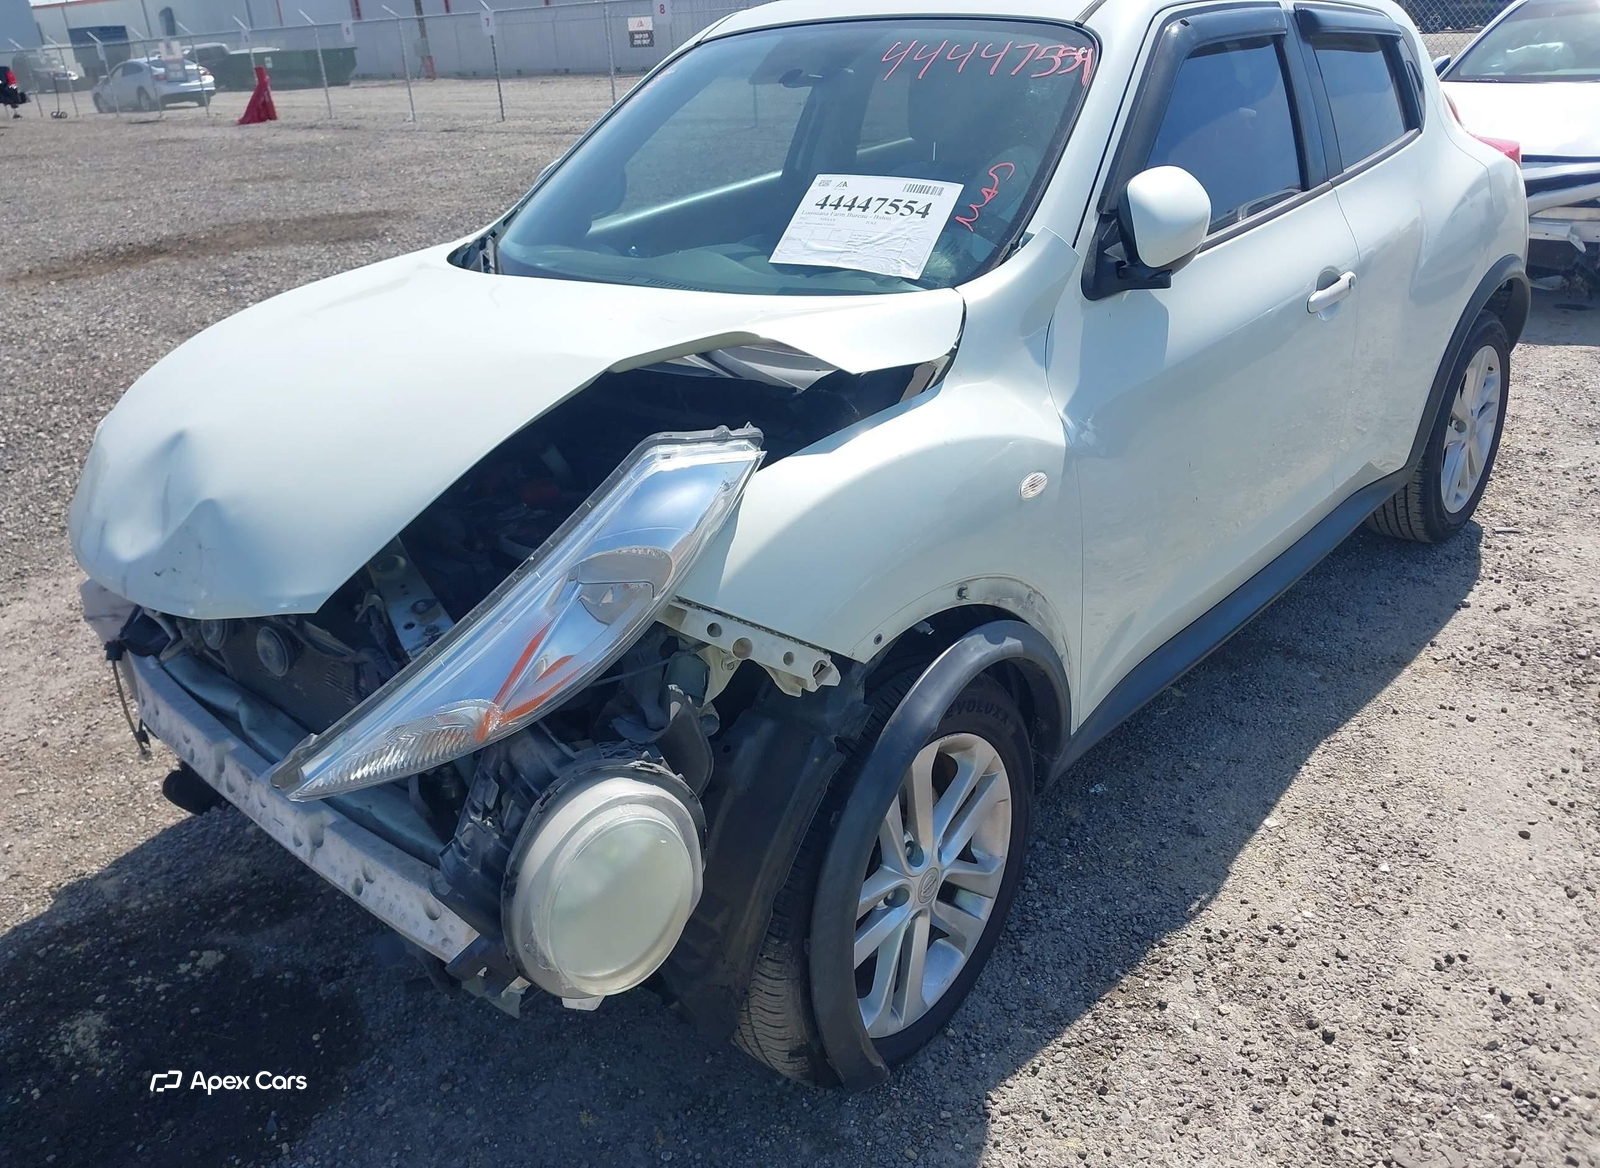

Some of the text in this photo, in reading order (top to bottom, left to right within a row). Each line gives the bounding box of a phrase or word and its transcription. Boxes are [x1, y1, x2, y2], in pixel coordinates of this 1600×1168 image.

[659, 3, 666, 14] 8
[485, 17, 490, 27] 7
[814, 194, 933, 219] 44447554
